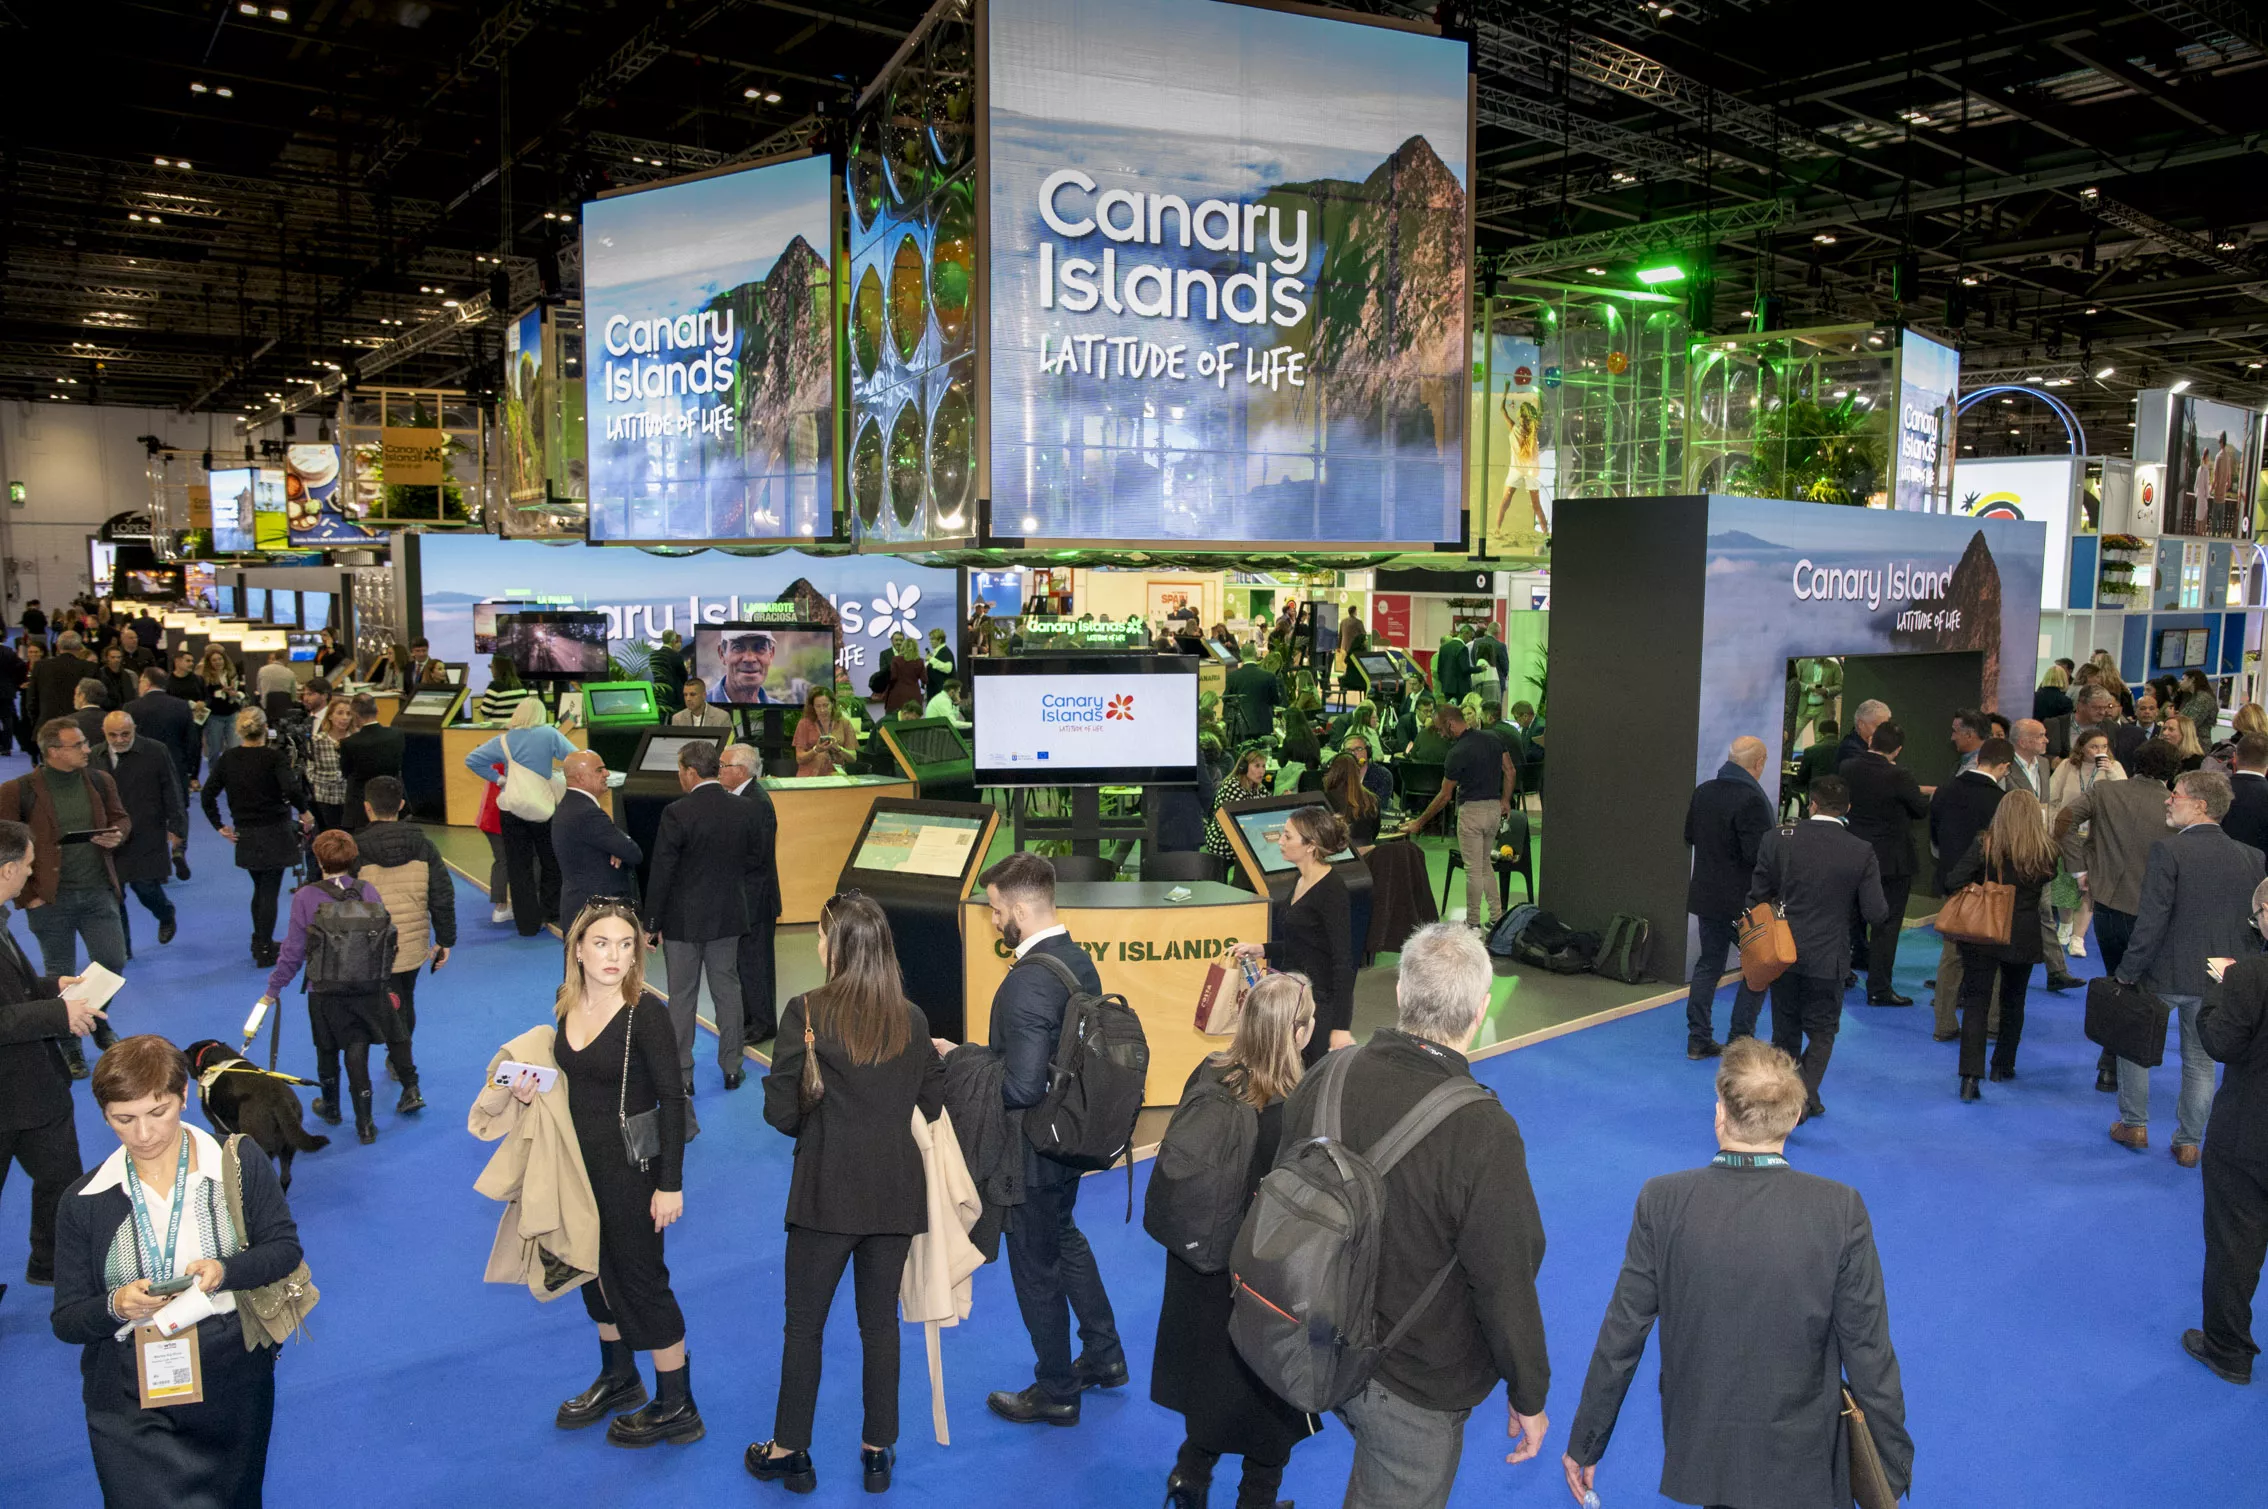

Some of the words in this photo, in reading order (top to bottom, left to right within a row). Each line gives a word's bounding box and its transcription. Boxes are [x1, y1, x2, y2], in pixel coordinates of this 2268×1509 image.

[1038, 168, 1308, 275] Canary
[1039, 242, 1307, 327] Islands
[604, 308, 734, 357] Canary
[605, 350, 735, 402] Islands
[1039, 333, 1187, 380] LATITUDE
[1196, 343, 1240, 389] OF
[1246, 346, 1306, 392] LIFE
[606, 411, 673, 441] LATITUDE
[676, 407, 699, 439] OF
[701, 403, 735, 438] LIFE
[1904, 402, 1938, 442] Canary
[1902, 431, 1937, 463] Islands
[1793, 559, 1881, 611] Canary
[753, 611, 798, 623] GRACIOSA
[1026, 620, 1076, 635] Canary
[1079, 620, 1126, 632] Islands
[1896, 610, 1933, 632] LATITUDE
[1934, 610, 1945, 632] OF
[1945, 609, 1962, 632] LIFE
[835, 644, 865, 670] IFE
[1042, 694, 1104, 710] Canary
[1042, 709, 1104, 723] Islands
[1059, 725, 1083, 733] LATITUDE
[1092, 725, 1104, 733] LIFE
[994, 938, 1111, 962] CRY
[1119, 937, 1240, 961] ISLANDS
[130, 1171, 144, 1205] visitQATAR
[176, 1166, 186, 1202] visitQATAR
[141, 1212, 157, 1249] visitQATAR
[168, 1211, 180, 1249] visitQATAR
